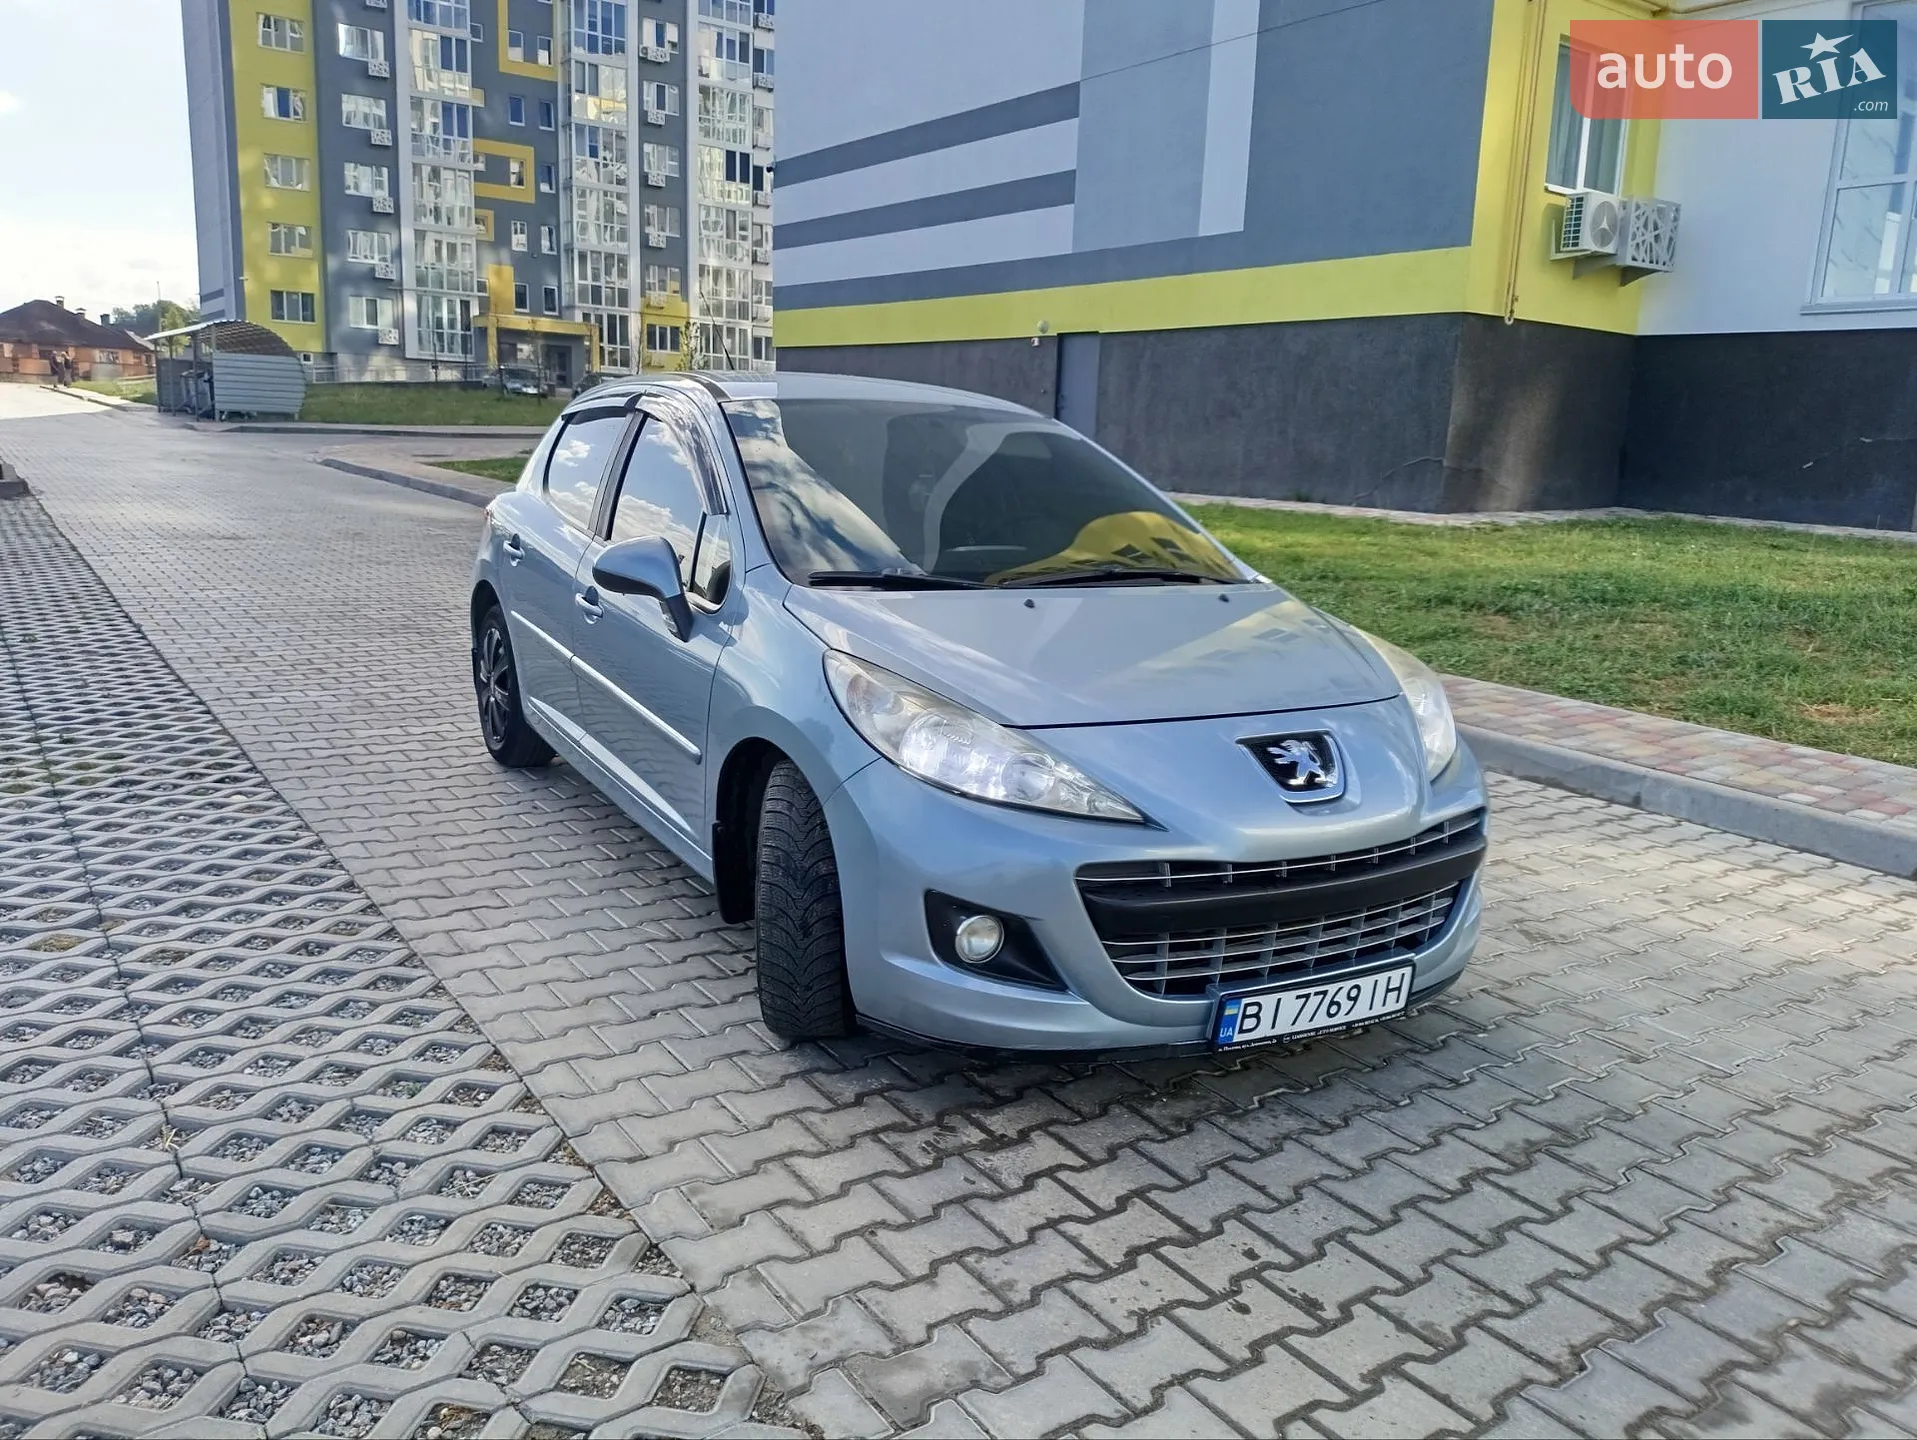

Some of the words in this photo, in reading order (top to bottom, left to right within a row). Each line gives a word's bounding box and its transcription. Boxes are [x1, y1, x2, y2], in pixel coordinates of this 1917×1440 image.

[1237, 998, 1282, 1035] BI
[1290, 984, 1361, 1027] 7769
[1369, 973, 1406, 1011] IH
[1219, 1027, 1233, 1038] UA
